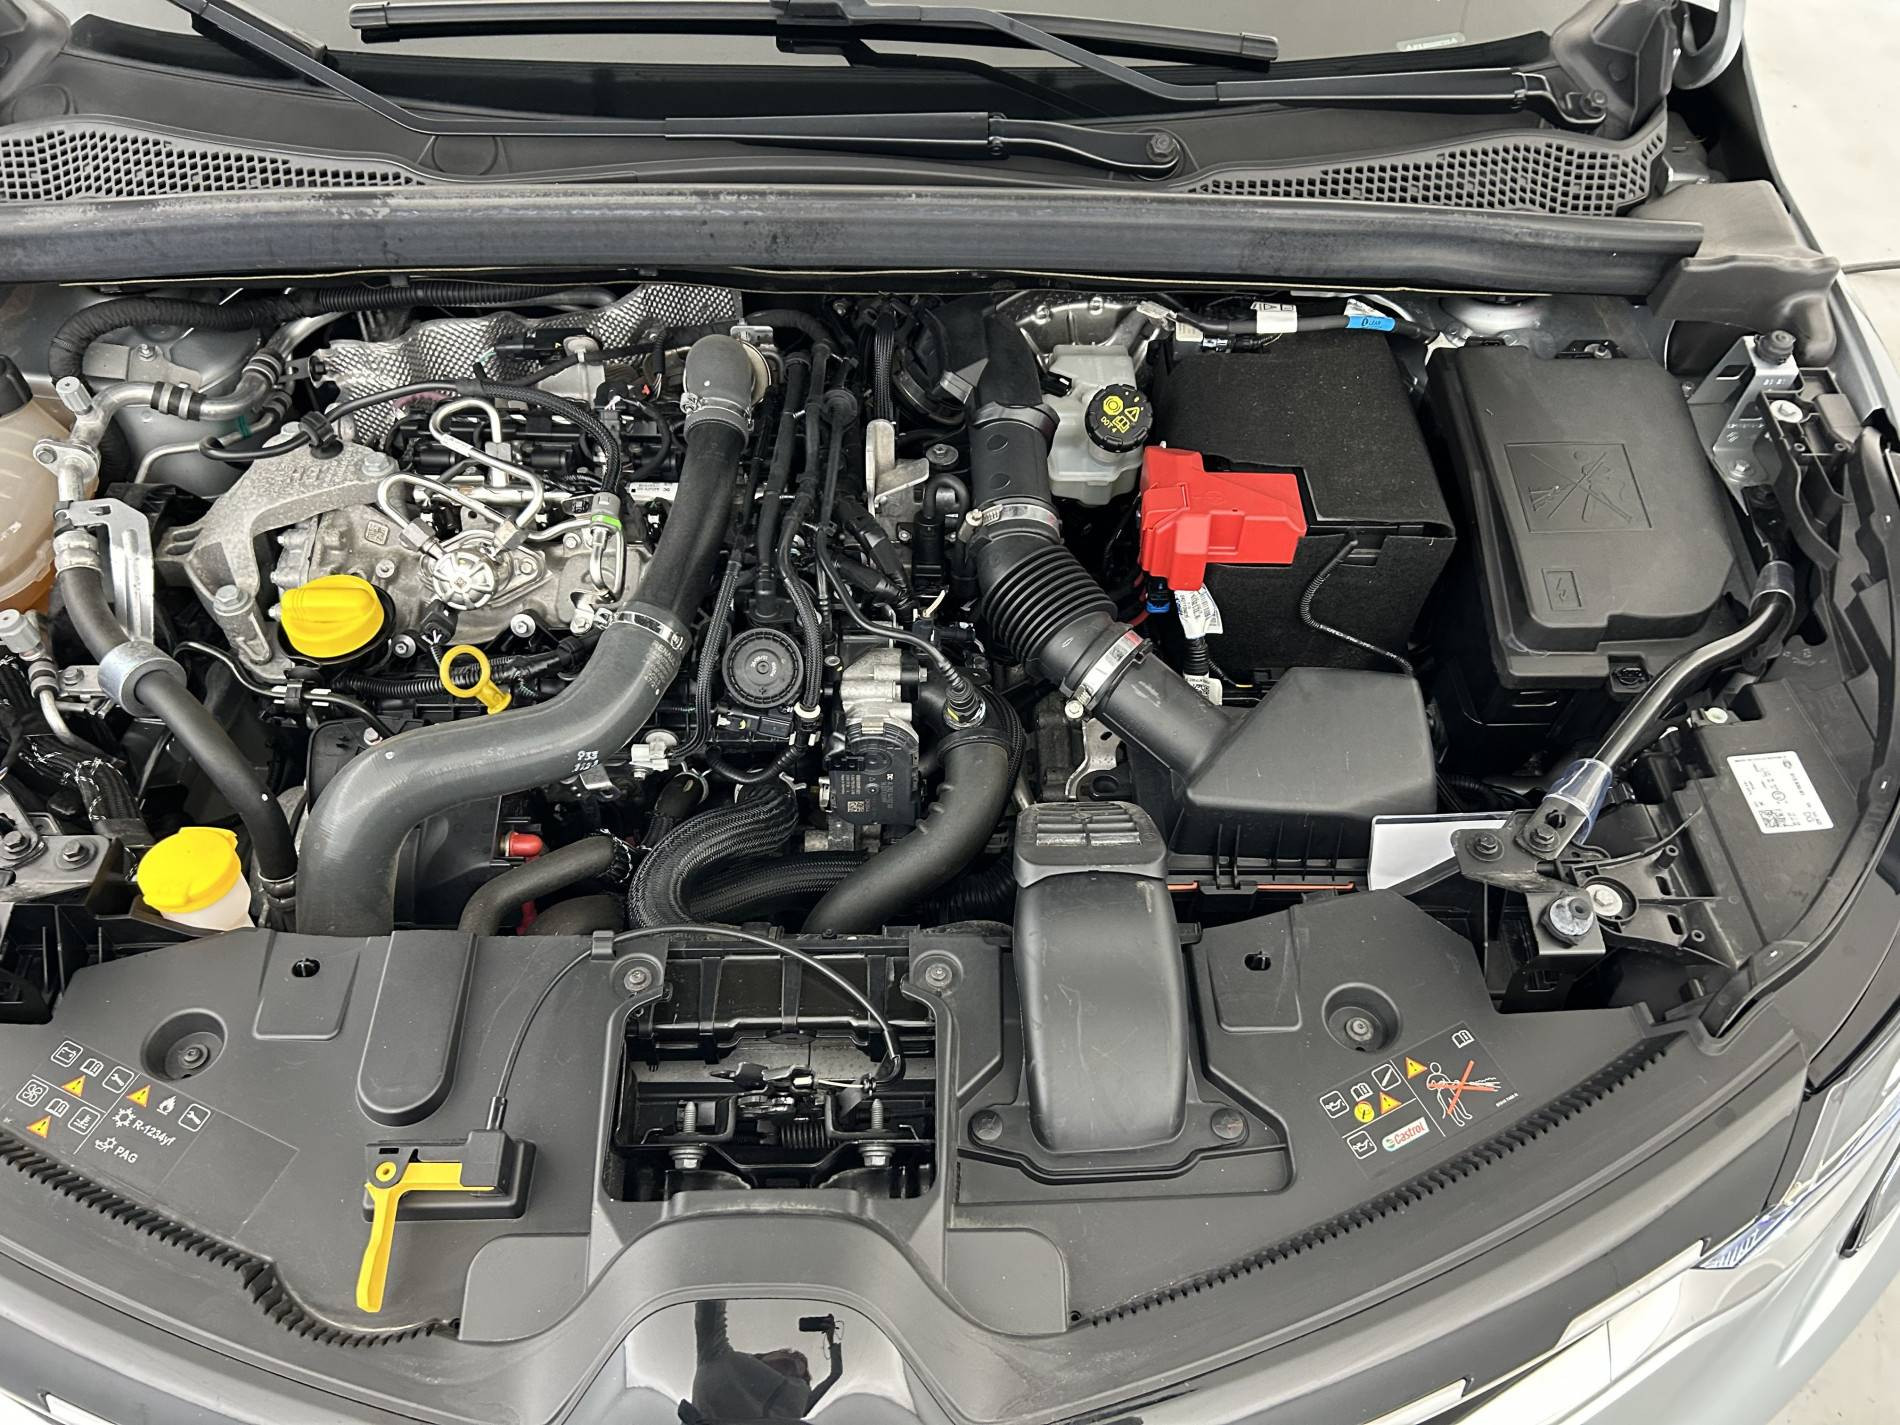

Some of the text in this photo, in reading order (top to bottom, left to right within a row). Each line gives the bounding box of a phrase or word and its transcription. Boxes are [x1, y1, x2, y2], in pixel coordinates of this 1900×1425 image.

[1101, 416, 1113, 429] DOT
[132, 1120, 176, 1146] R-1234yf
[1394, 1122, 1425, 1144] Castrol
[114, 1146, 138, 1164] PAG
